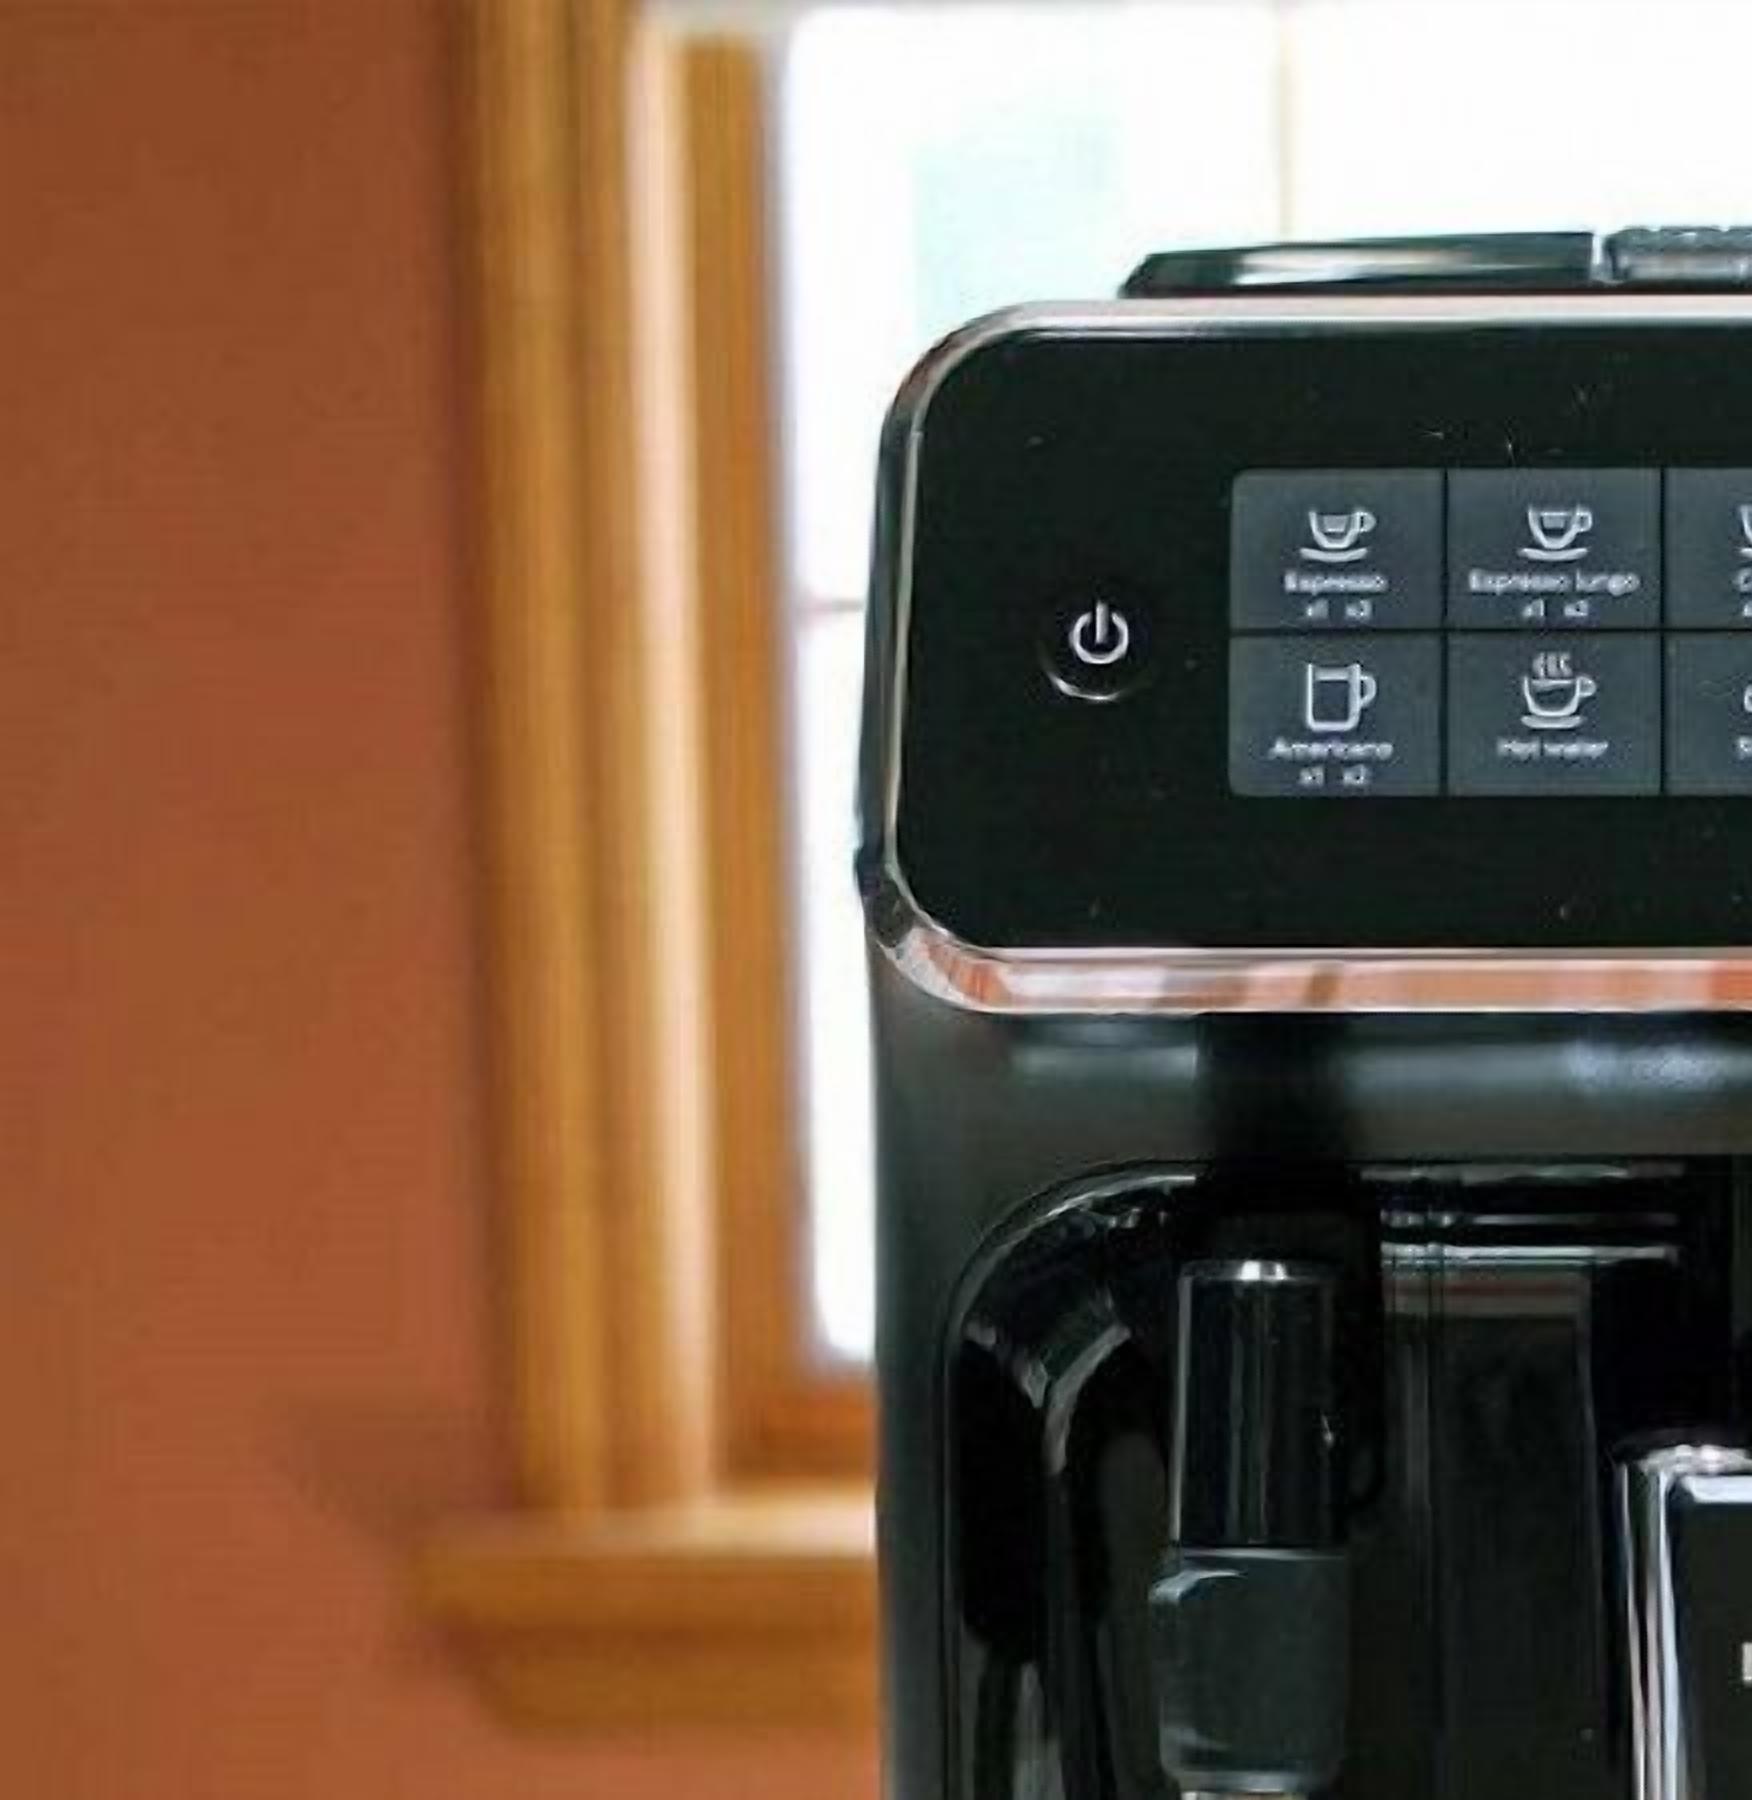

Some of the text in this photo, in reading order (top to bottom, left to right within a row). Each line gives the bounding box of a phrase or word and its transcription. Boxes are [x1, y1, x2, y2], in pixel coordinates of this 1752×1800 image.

[1284, 571, 1388, 596] Espresso
[1469, 568, 1640, 597] Espresso lungo
[1268, 736, 1394, 761] Americano
[1497, 736, 1609, 760] Hot water
